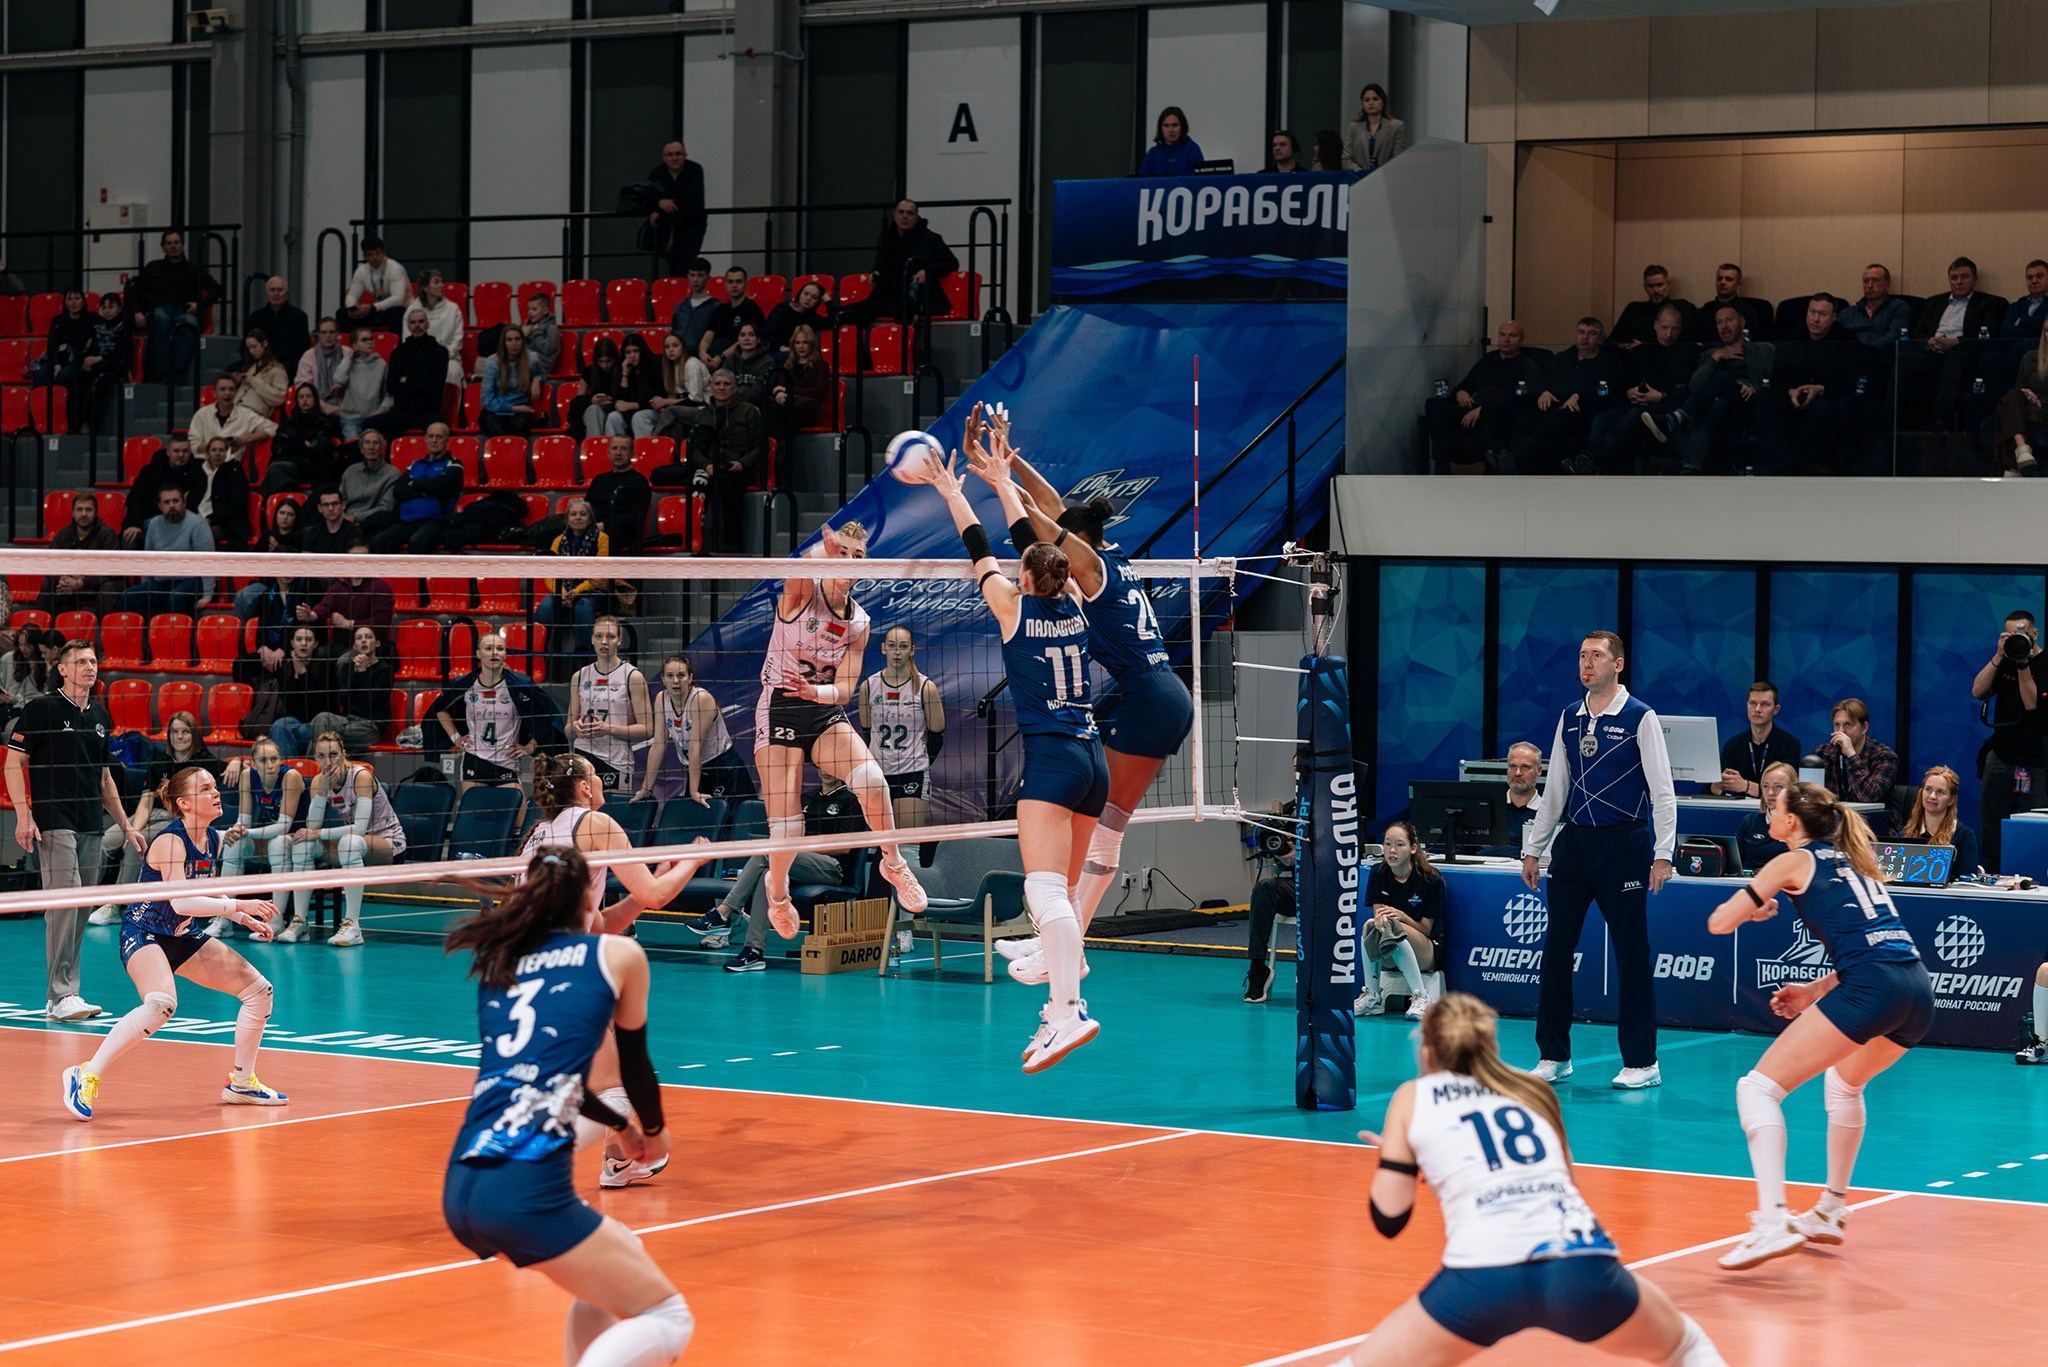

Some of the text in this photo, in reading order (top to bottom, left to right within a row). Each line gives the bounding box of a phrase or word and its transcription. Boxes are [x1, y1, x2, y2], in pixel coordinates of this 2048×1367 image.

[852, 578, 970, 594] ОРСКОЙ
[882, 597, 990, 611] УНИВЕР
[1045, 645, 1083, 700] 11
[482, 722, 497, 746] 4
[774, 727, 796, 741] 23
[879, 724, 908, 750] 22
[1330, 772, 1358, 984] КОРАБЕЛКА
[1908, 857, 1948, 882] 20
[1836, 867, 1900, 920] 14
[516, 943, 588, 976] ТЕРОВА
[840, 946, 881, 965] DARPO
[1653, 953, 1715, 981] ВФВ
[1482, 971, 1530, 984] ЧЕМПИОНАТ
[1762, 964, 1834, 983] КОРАБЕЛ
[1928, 972, 2024, 998] ПЕРЛИГА
[1933, 998, 2002, 1012] ИОНАТ РОССИИ
[496, 978, 545, 1059] 3
[1460, 1106, 1546, 1172] 18
